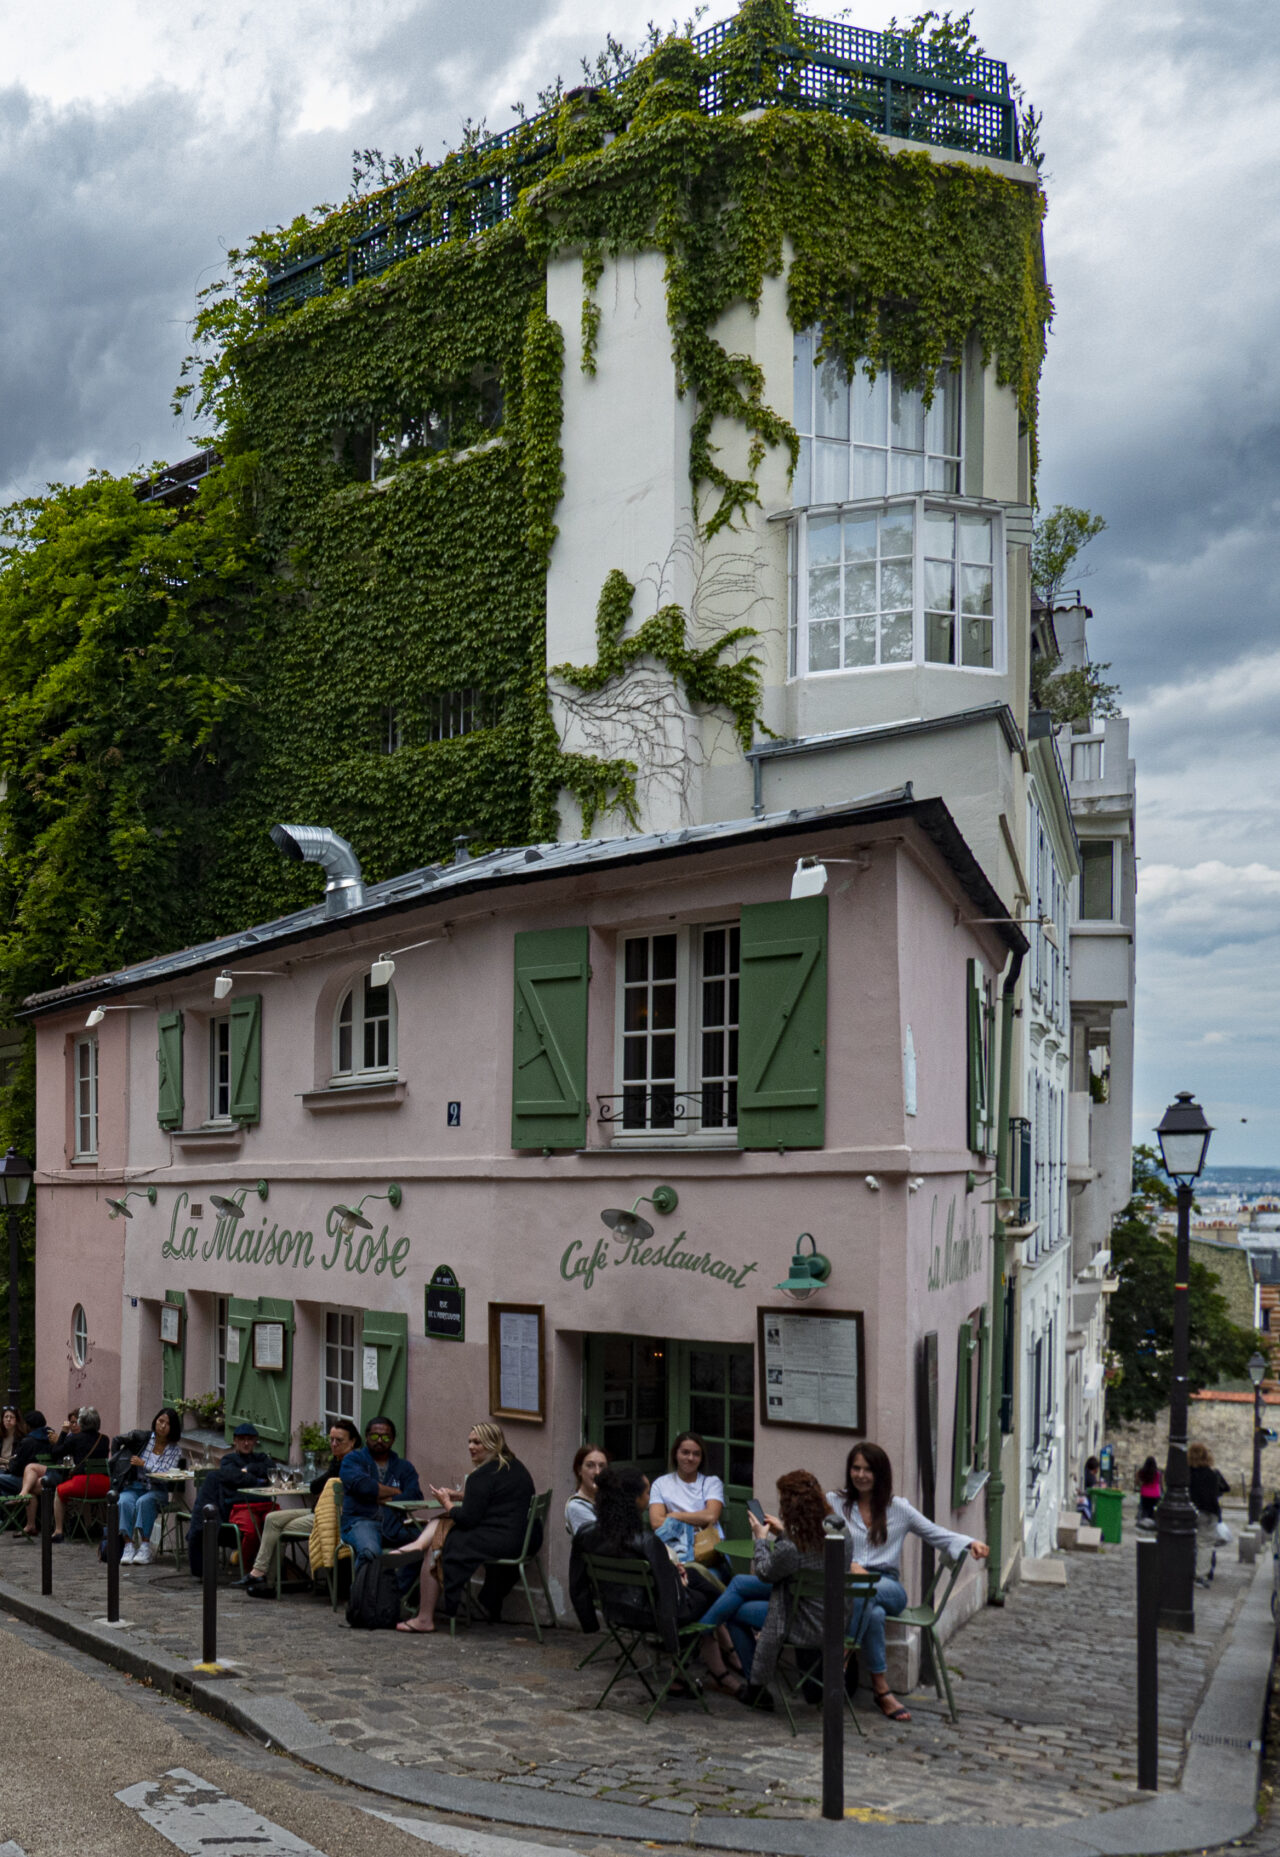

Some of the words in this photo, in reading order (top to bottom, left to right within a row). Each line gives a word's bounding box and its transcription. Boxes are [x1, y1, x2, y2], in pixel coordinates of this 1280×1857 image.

[162, 1191, 199, 1260] La
[201, 1191, 315, 1269] Maison
[321, 1206, 411, 1279] Rose
[559, 1238, 609, 1290] Café
[614, 1230, 758, 1289] Restaurant
